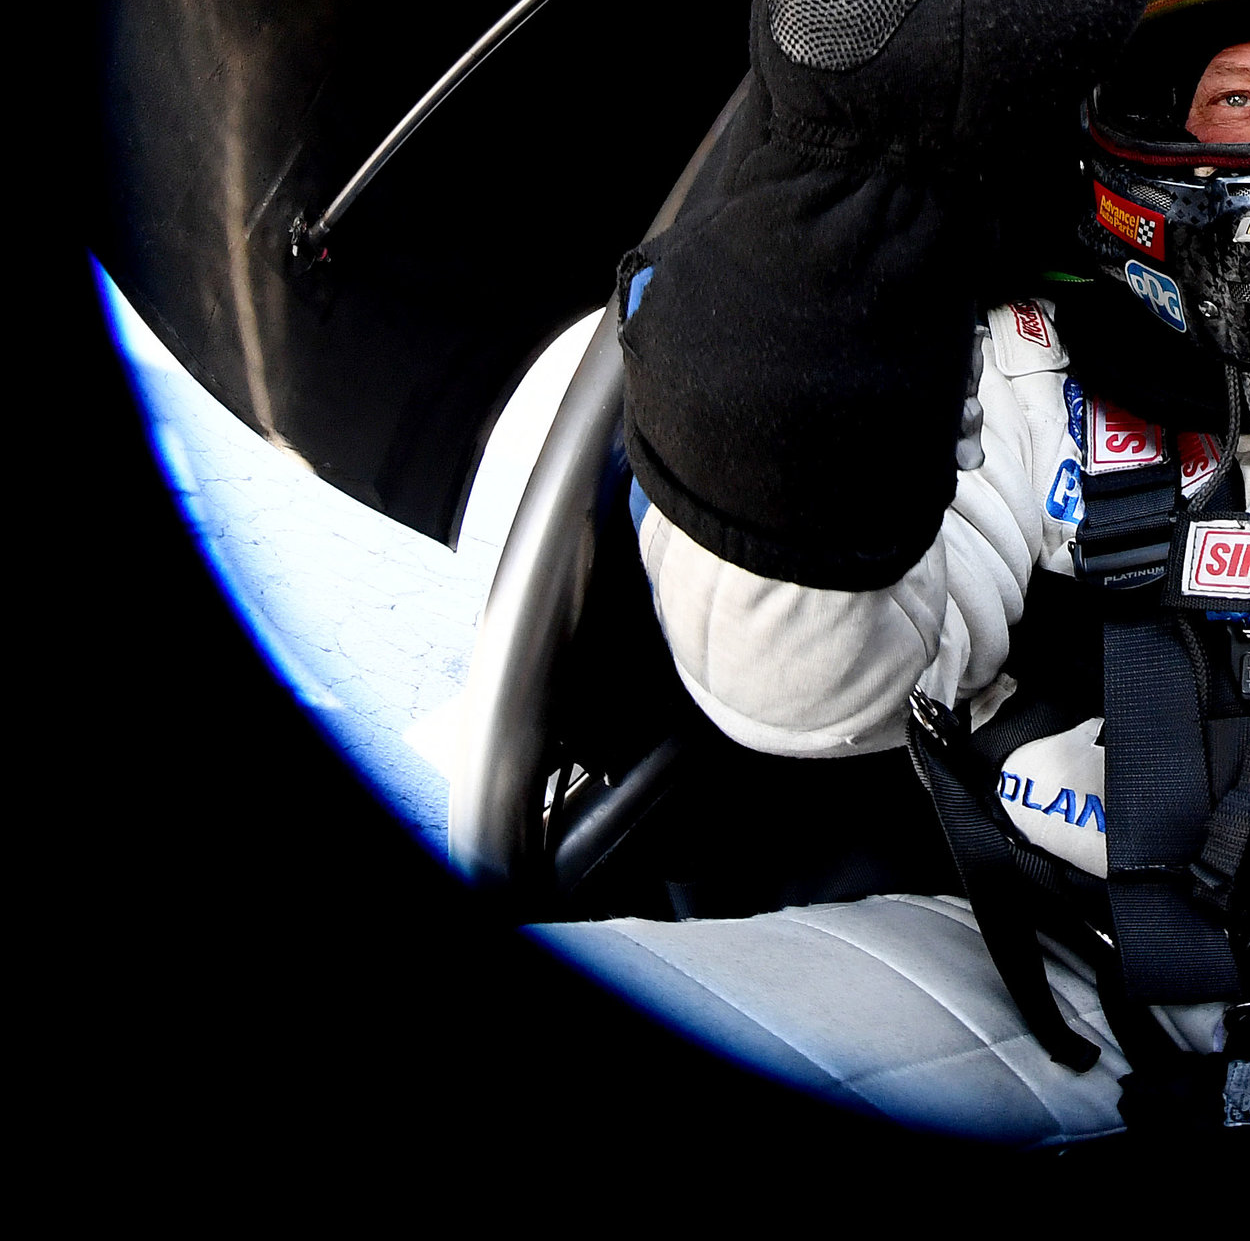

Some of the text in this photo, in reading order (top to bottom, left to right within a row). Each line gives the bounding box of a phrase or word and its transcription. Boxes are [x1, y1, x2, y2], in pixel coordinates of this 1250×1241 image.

[1100, 194, 1136, 227] Advance
[1113, 216, 1134, 238] Parts
[1130, 271, 1182, 322] PPG
[1104, 565, 1165, 586] PLATINUM
